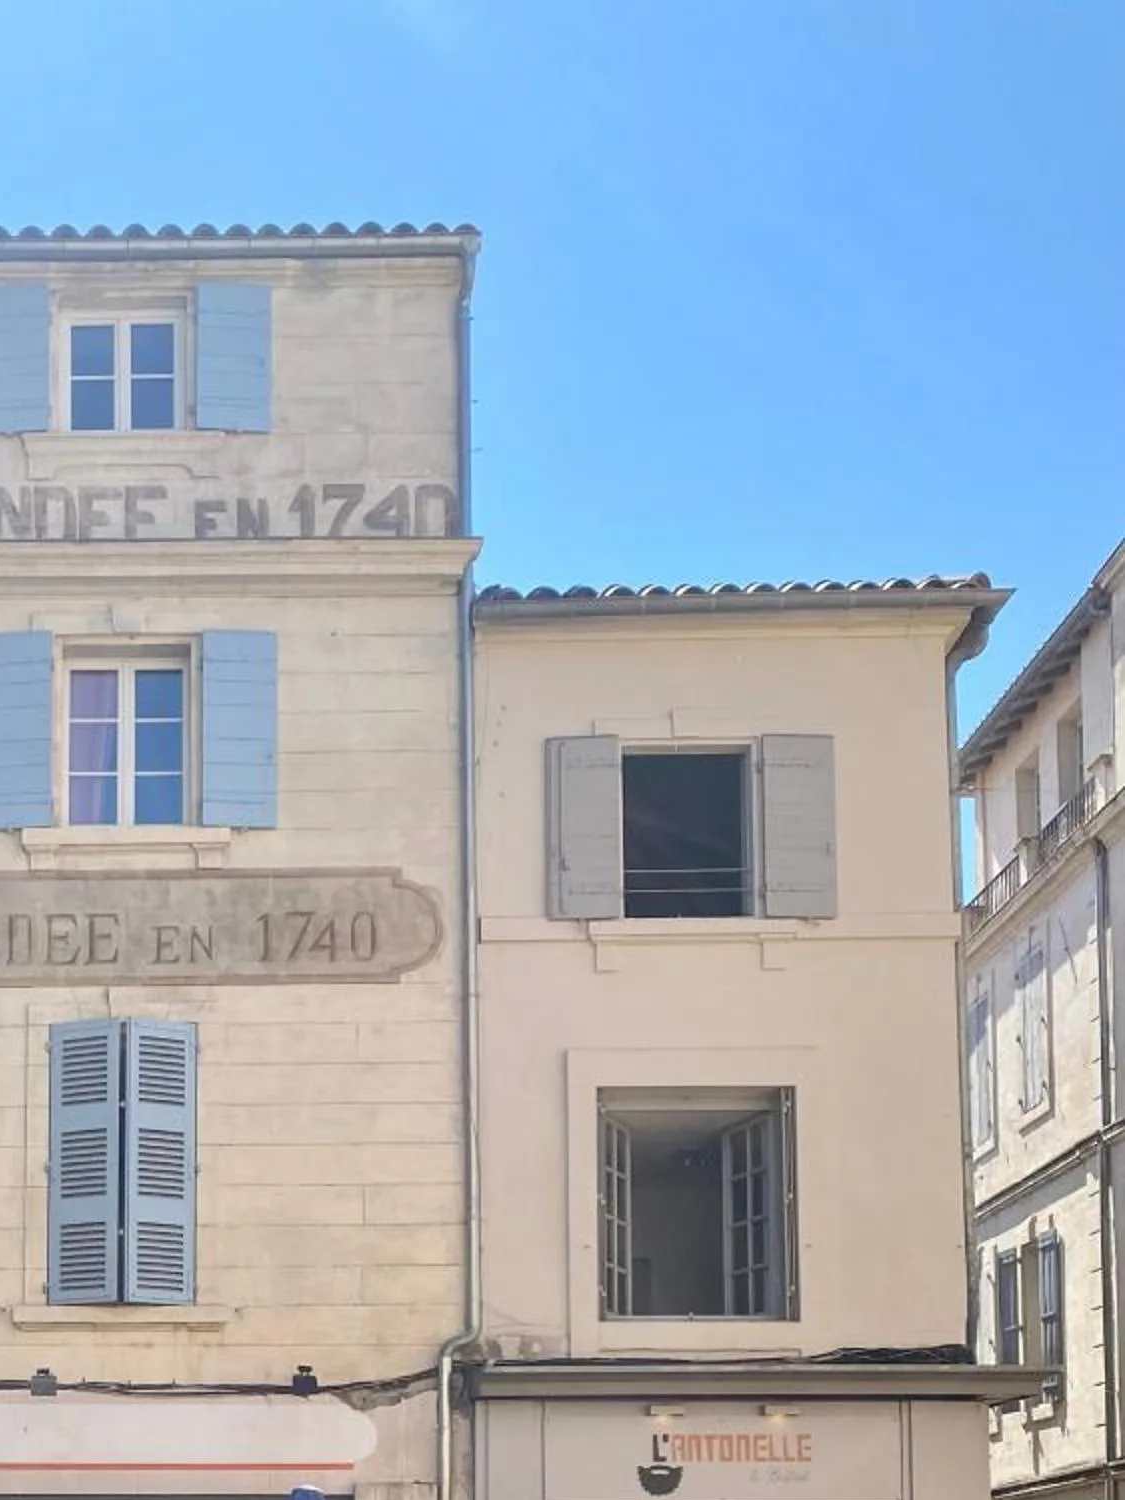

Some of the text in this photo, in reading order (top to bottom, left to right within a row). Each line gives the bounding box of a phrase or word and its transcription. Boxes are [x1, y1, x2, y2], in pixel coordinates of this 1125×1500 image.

[288, 483, 461, 538] 1740
[152, 925, 214, 964] EN
[256, 911, 377, 963] 1740
[652, 1434, 812, 1462] L'ANTONELLE
